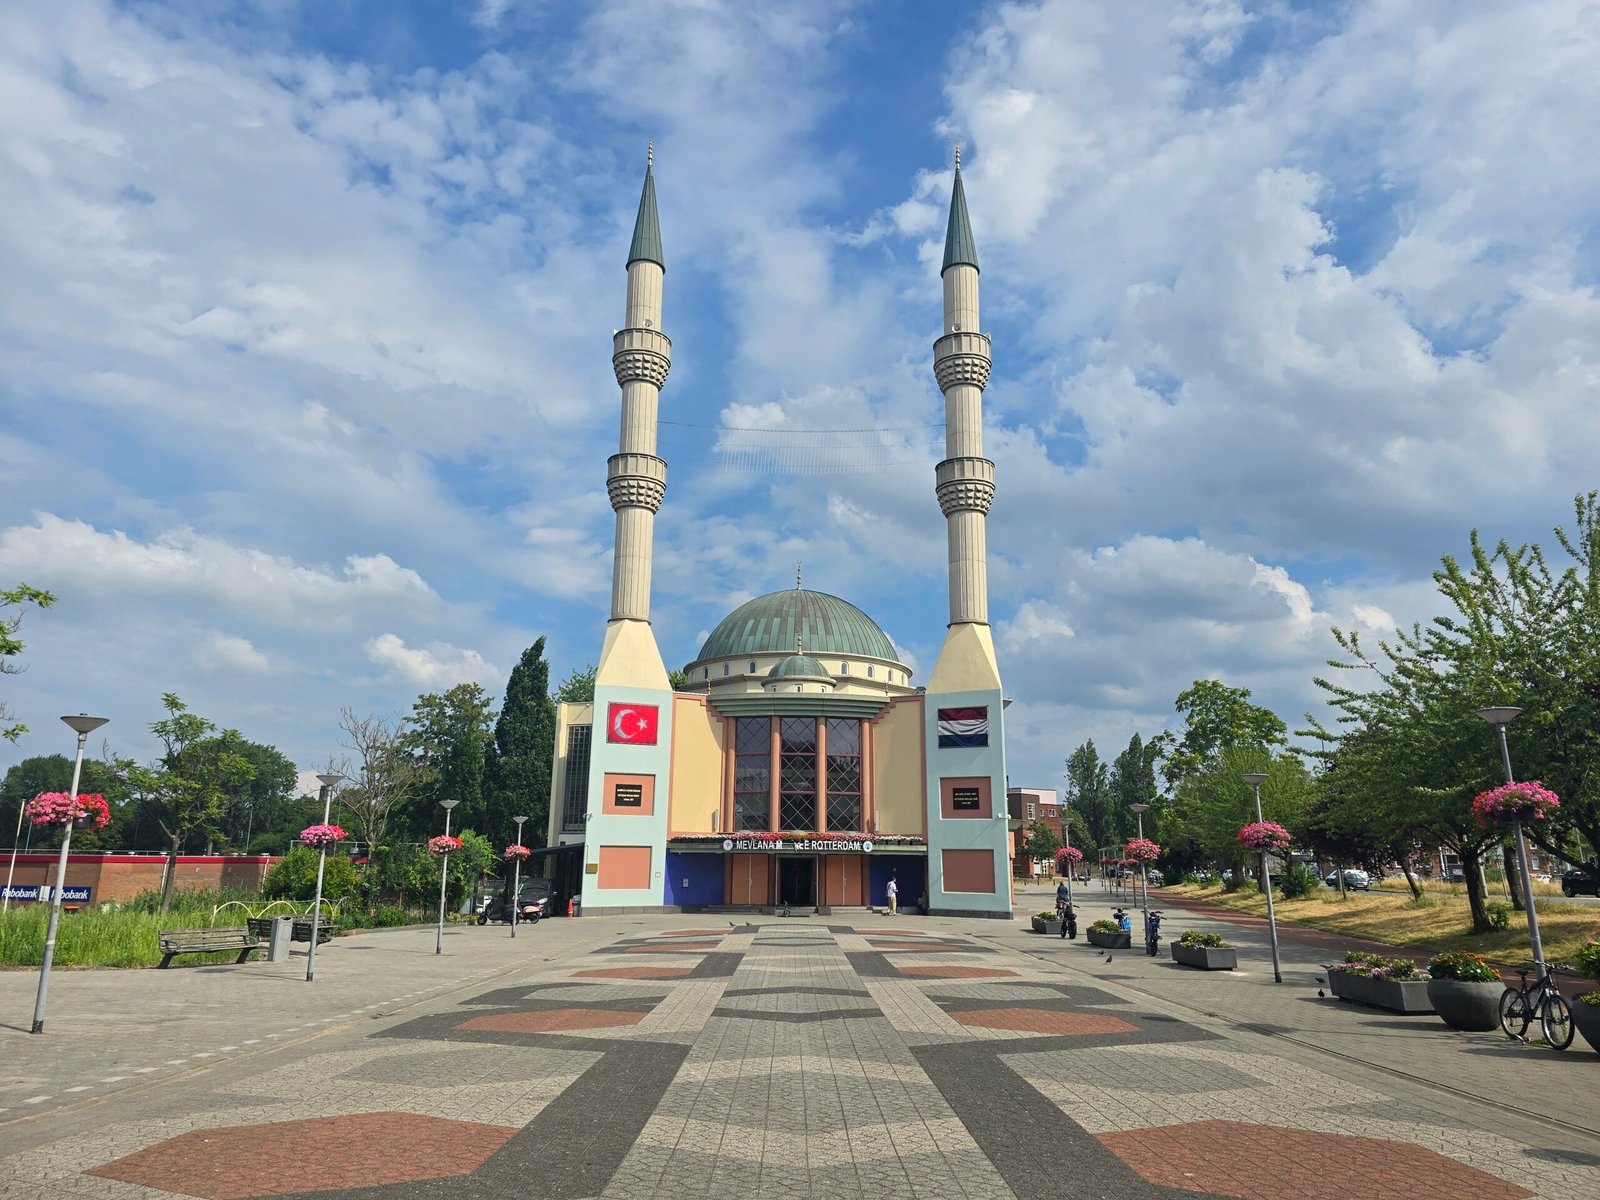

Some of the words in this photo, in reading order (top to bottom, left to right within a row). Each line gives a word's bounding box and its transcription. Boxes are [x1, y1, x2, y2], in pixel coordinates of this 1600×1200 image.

[736, 840, 775, 850] MEVLANA
[811, 840, 860, 851] ROTTERDAM
[1, 888, 38, 898] Rabobank
[50, 889, 89, 899] bobank
